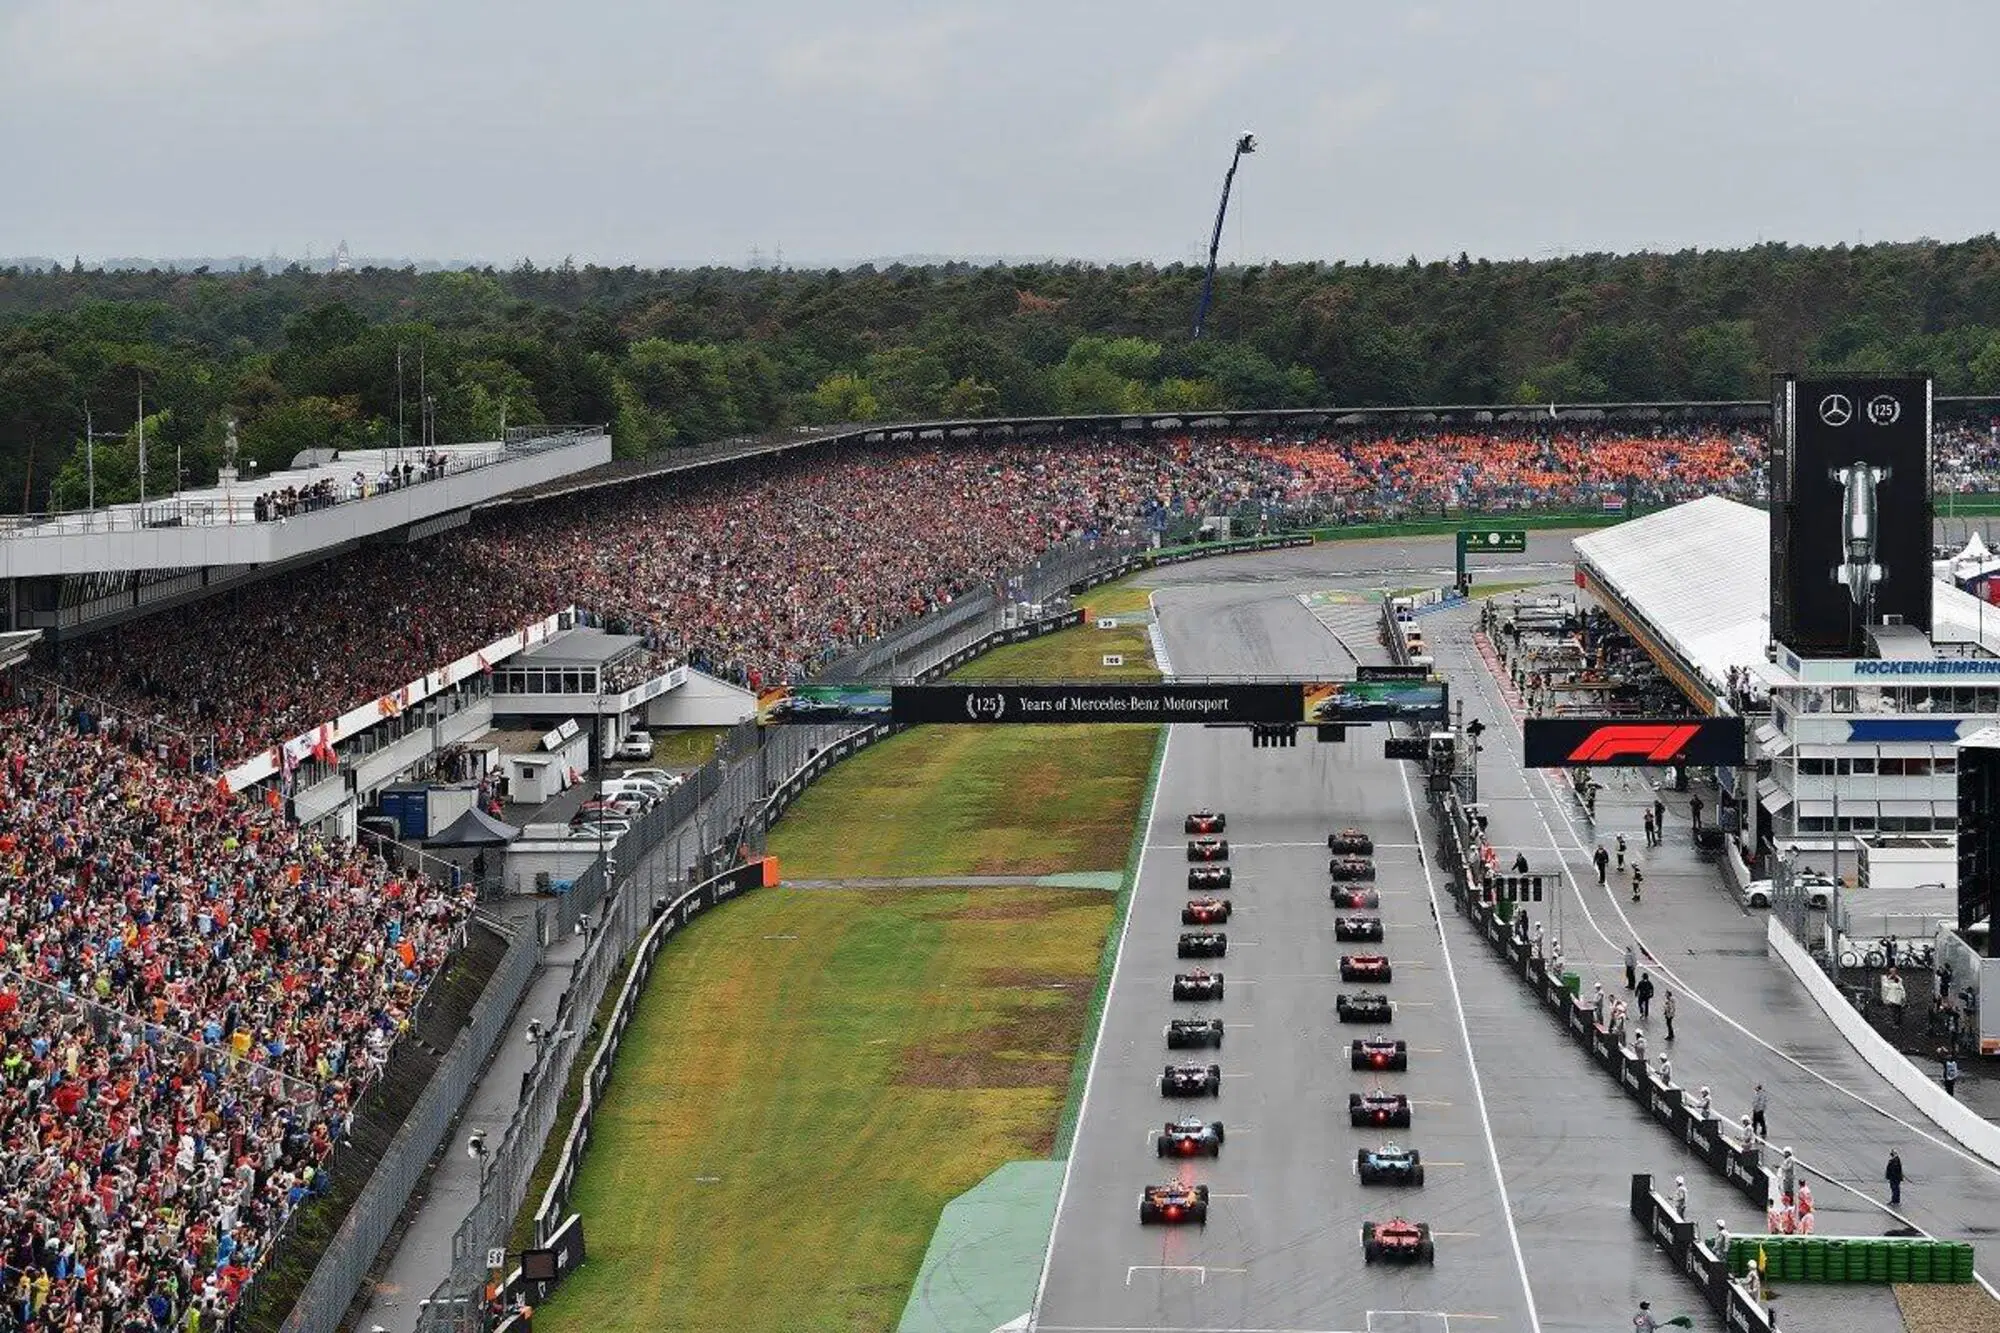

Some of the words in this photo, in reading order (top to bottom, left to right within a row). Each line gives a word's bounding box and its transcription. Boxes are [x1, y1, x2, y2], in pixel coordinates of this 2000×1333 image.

[1875, 404, 1893, 416] 125
[1854, 660, 2000, 674] HOCKENHEIMRIN
[976, 697, 996, 711] 125
[1019, 697, 1053, 711] Years
[1055, 697, 1068, 711] of
[1070, 696, 1160, 711] Mercedes-Benz
[1162, 696, 1229, 713] Motorsport
